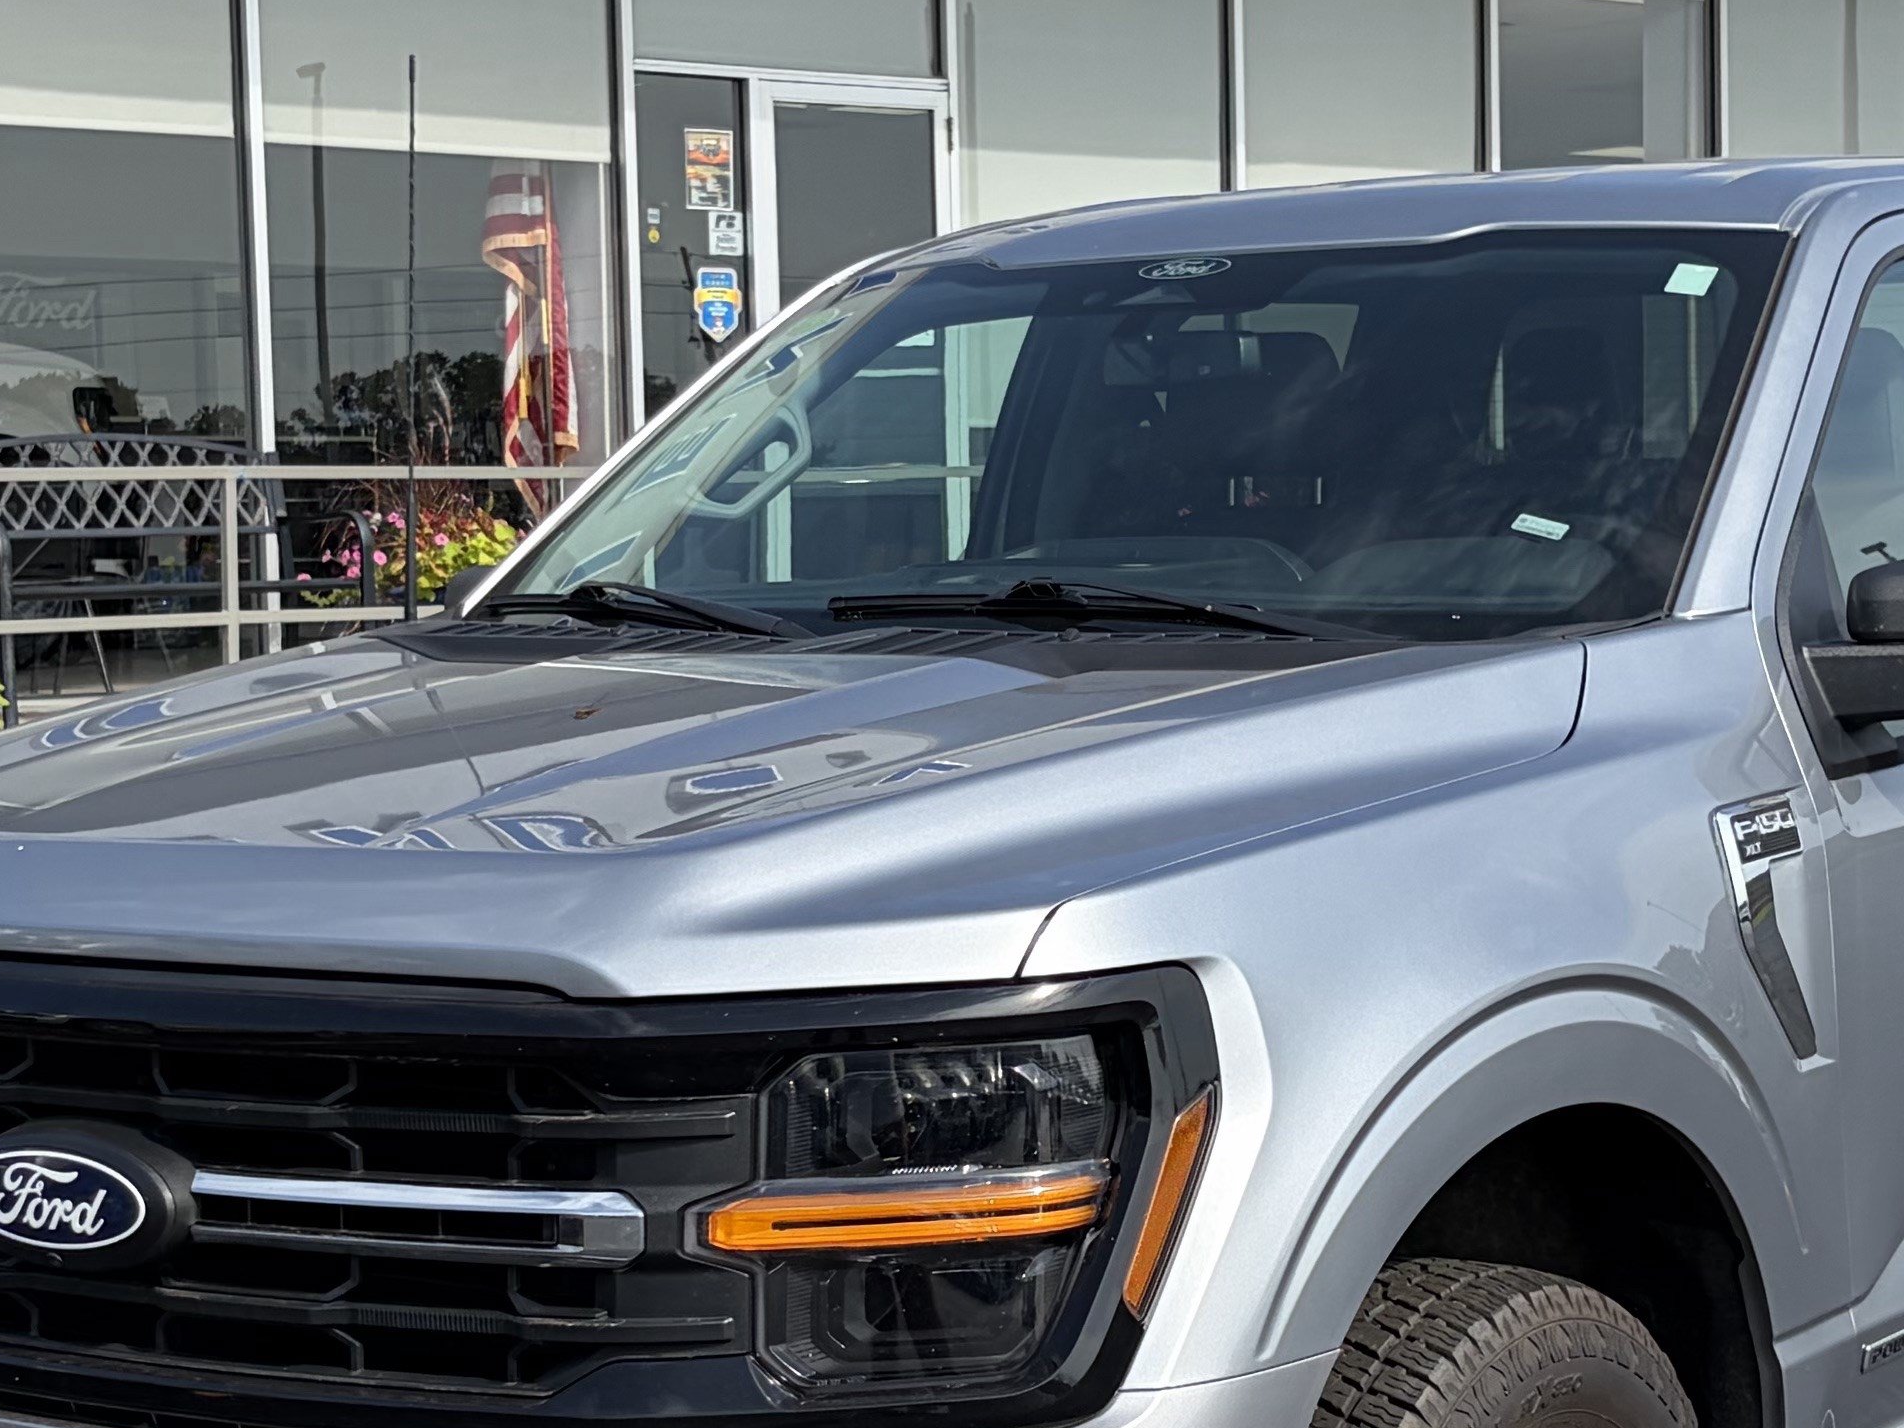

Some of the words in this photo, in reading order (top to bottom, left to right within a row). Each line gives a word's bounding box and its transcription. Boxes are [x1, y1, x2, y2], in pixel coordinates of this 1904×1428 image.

[1151, 260, 1217, 277] Ford
[1734, 807, 1795, 841] F-150
[1744, 841, 1762, 857] XLT
